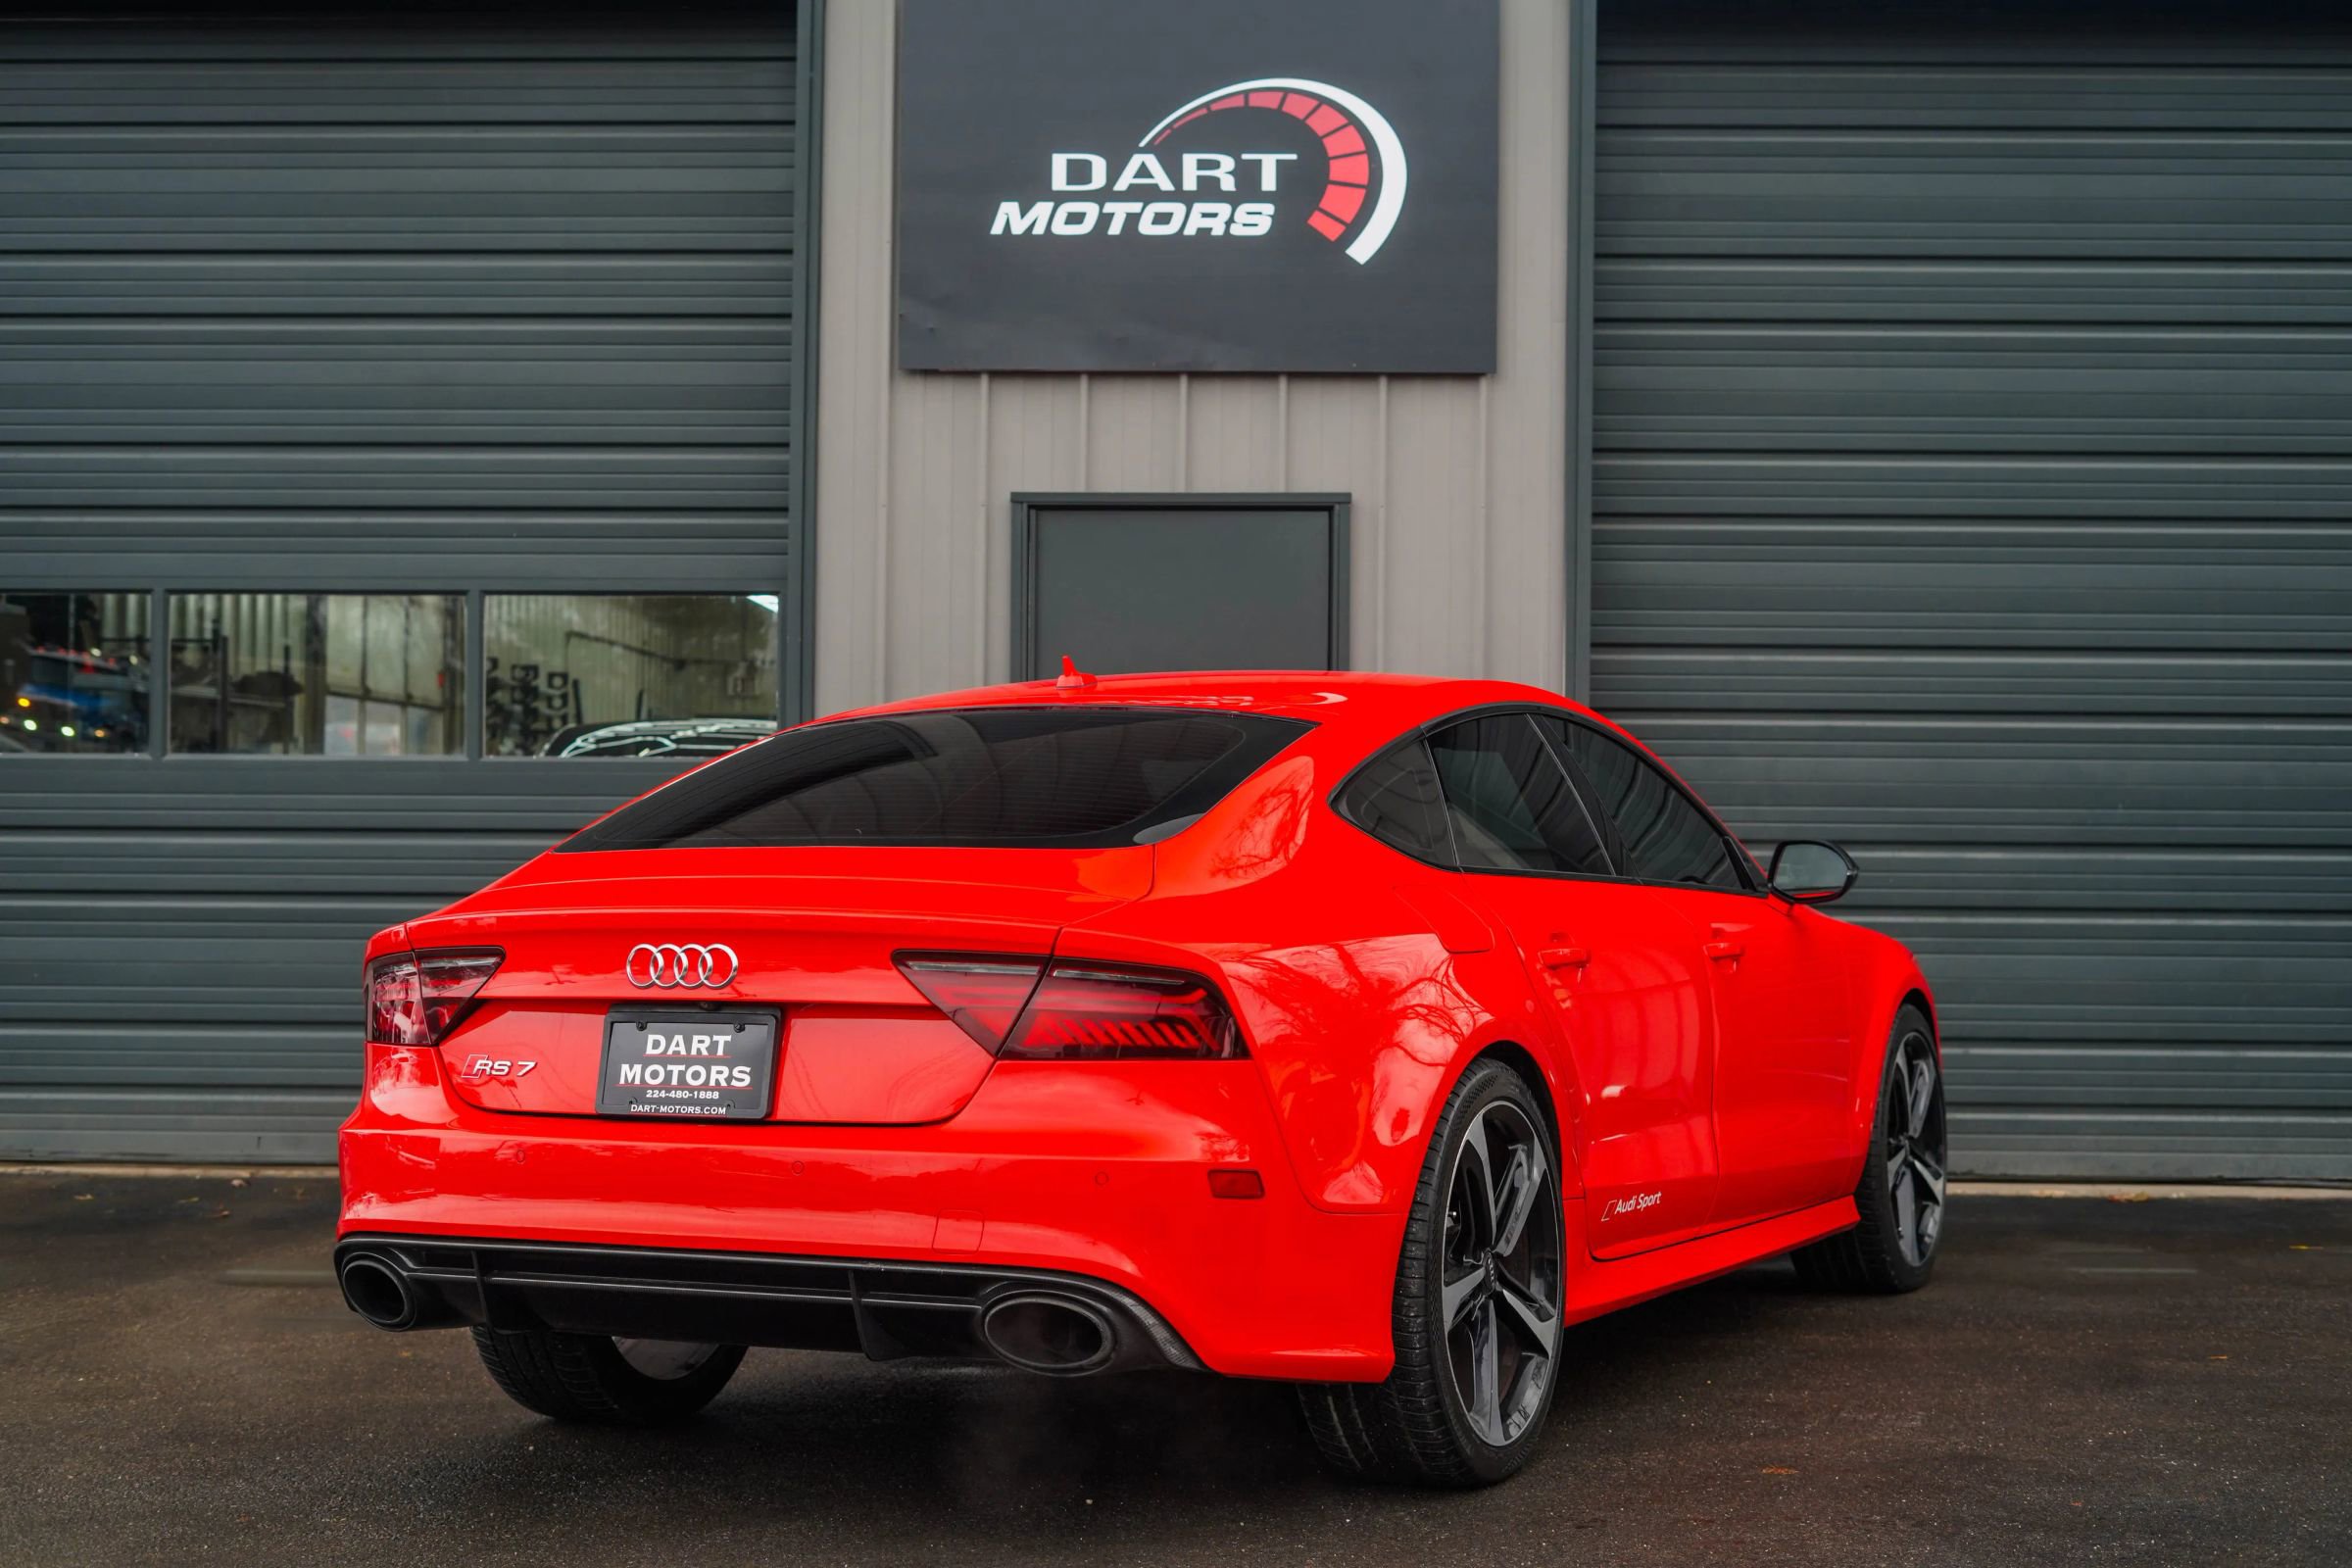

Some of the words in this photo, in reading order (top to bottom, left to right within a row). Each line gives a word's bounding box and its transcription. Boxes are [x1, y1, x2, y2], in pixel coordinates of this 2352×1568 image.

[1052, 153, 1298, 191] DART
[990, 201, 1275, 236] MOTORS
[646, 1034, 732, 1056] DART
[619, 1063, 752, 1087] MOTORS
[646, 1090, 719, 1099] 224-480-1888
[630, 1103, 727, 1115] DART-MOTORS.COM
[1614, 1195, 1638, 1215] Audi
[1636, 1191, 1662, 1211] Sport
